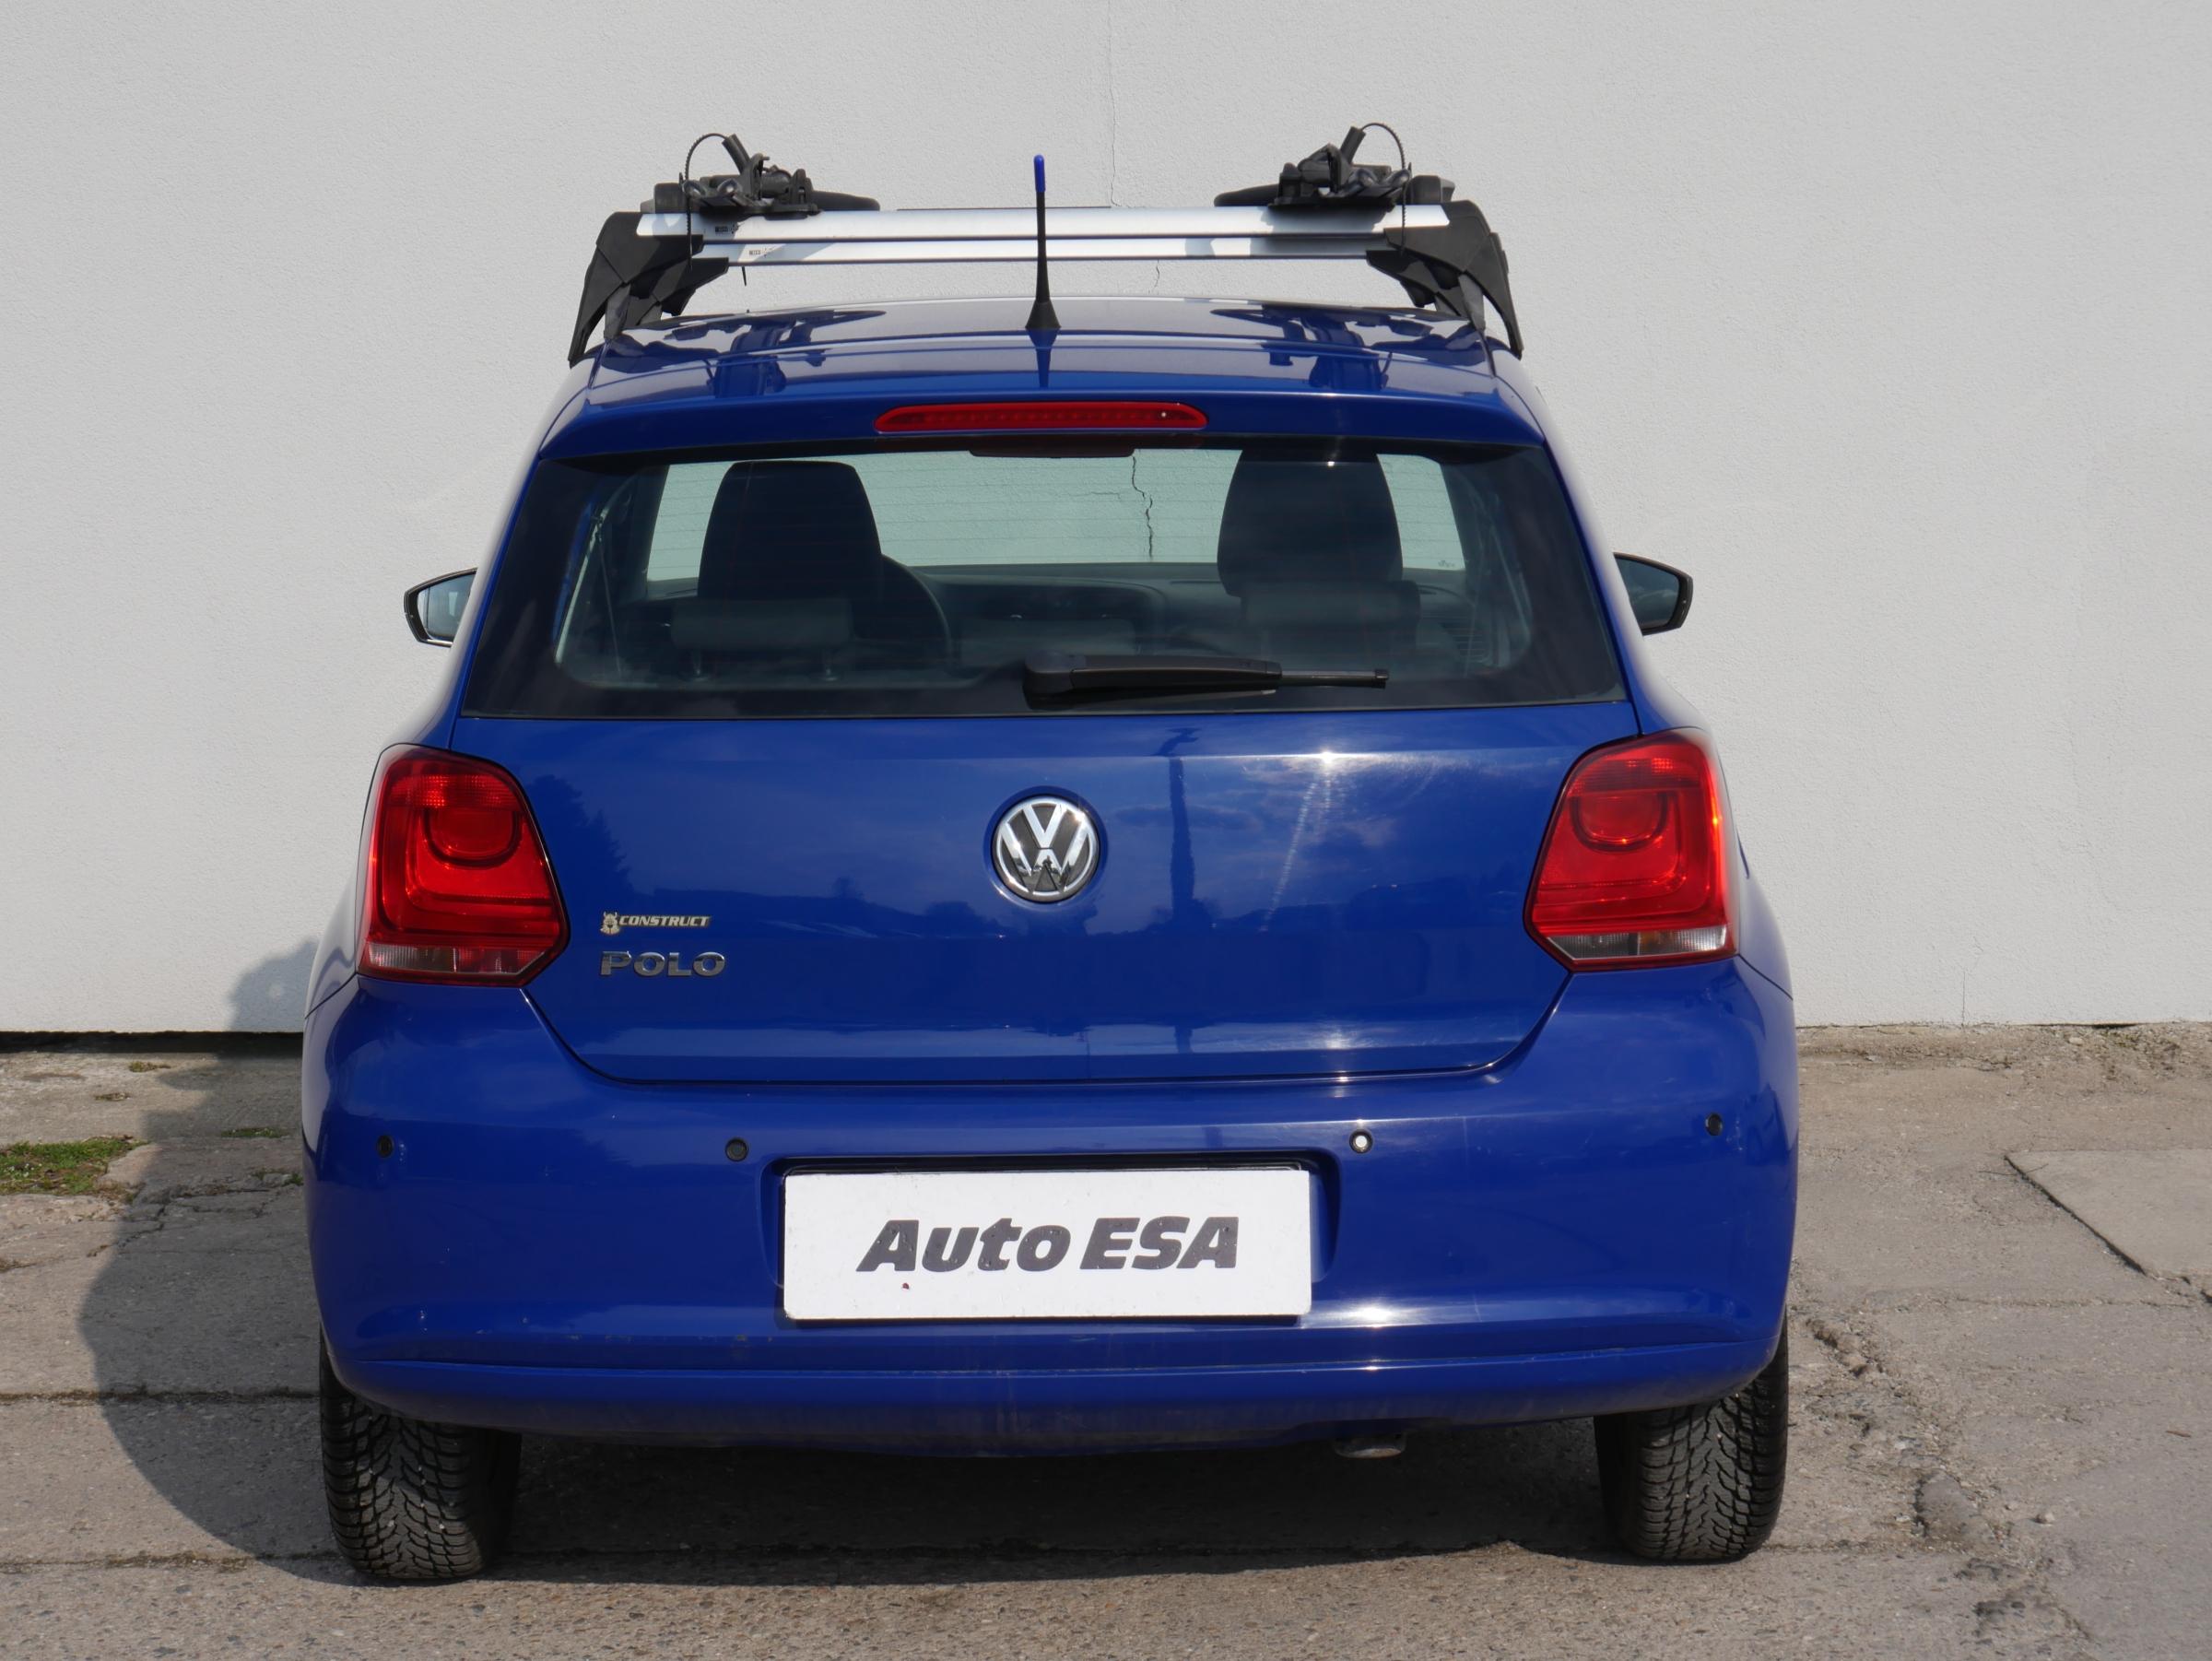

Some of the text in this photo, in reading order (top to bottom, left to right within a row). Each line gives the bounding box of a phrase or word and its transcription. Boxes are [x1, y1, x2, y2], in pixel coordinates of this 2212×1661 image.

[618, 914, 711, 927] CONSTRUCT
[600, 950, 725, 977] POLO
[855, 1216, 1239, 1272] Auto ESA
